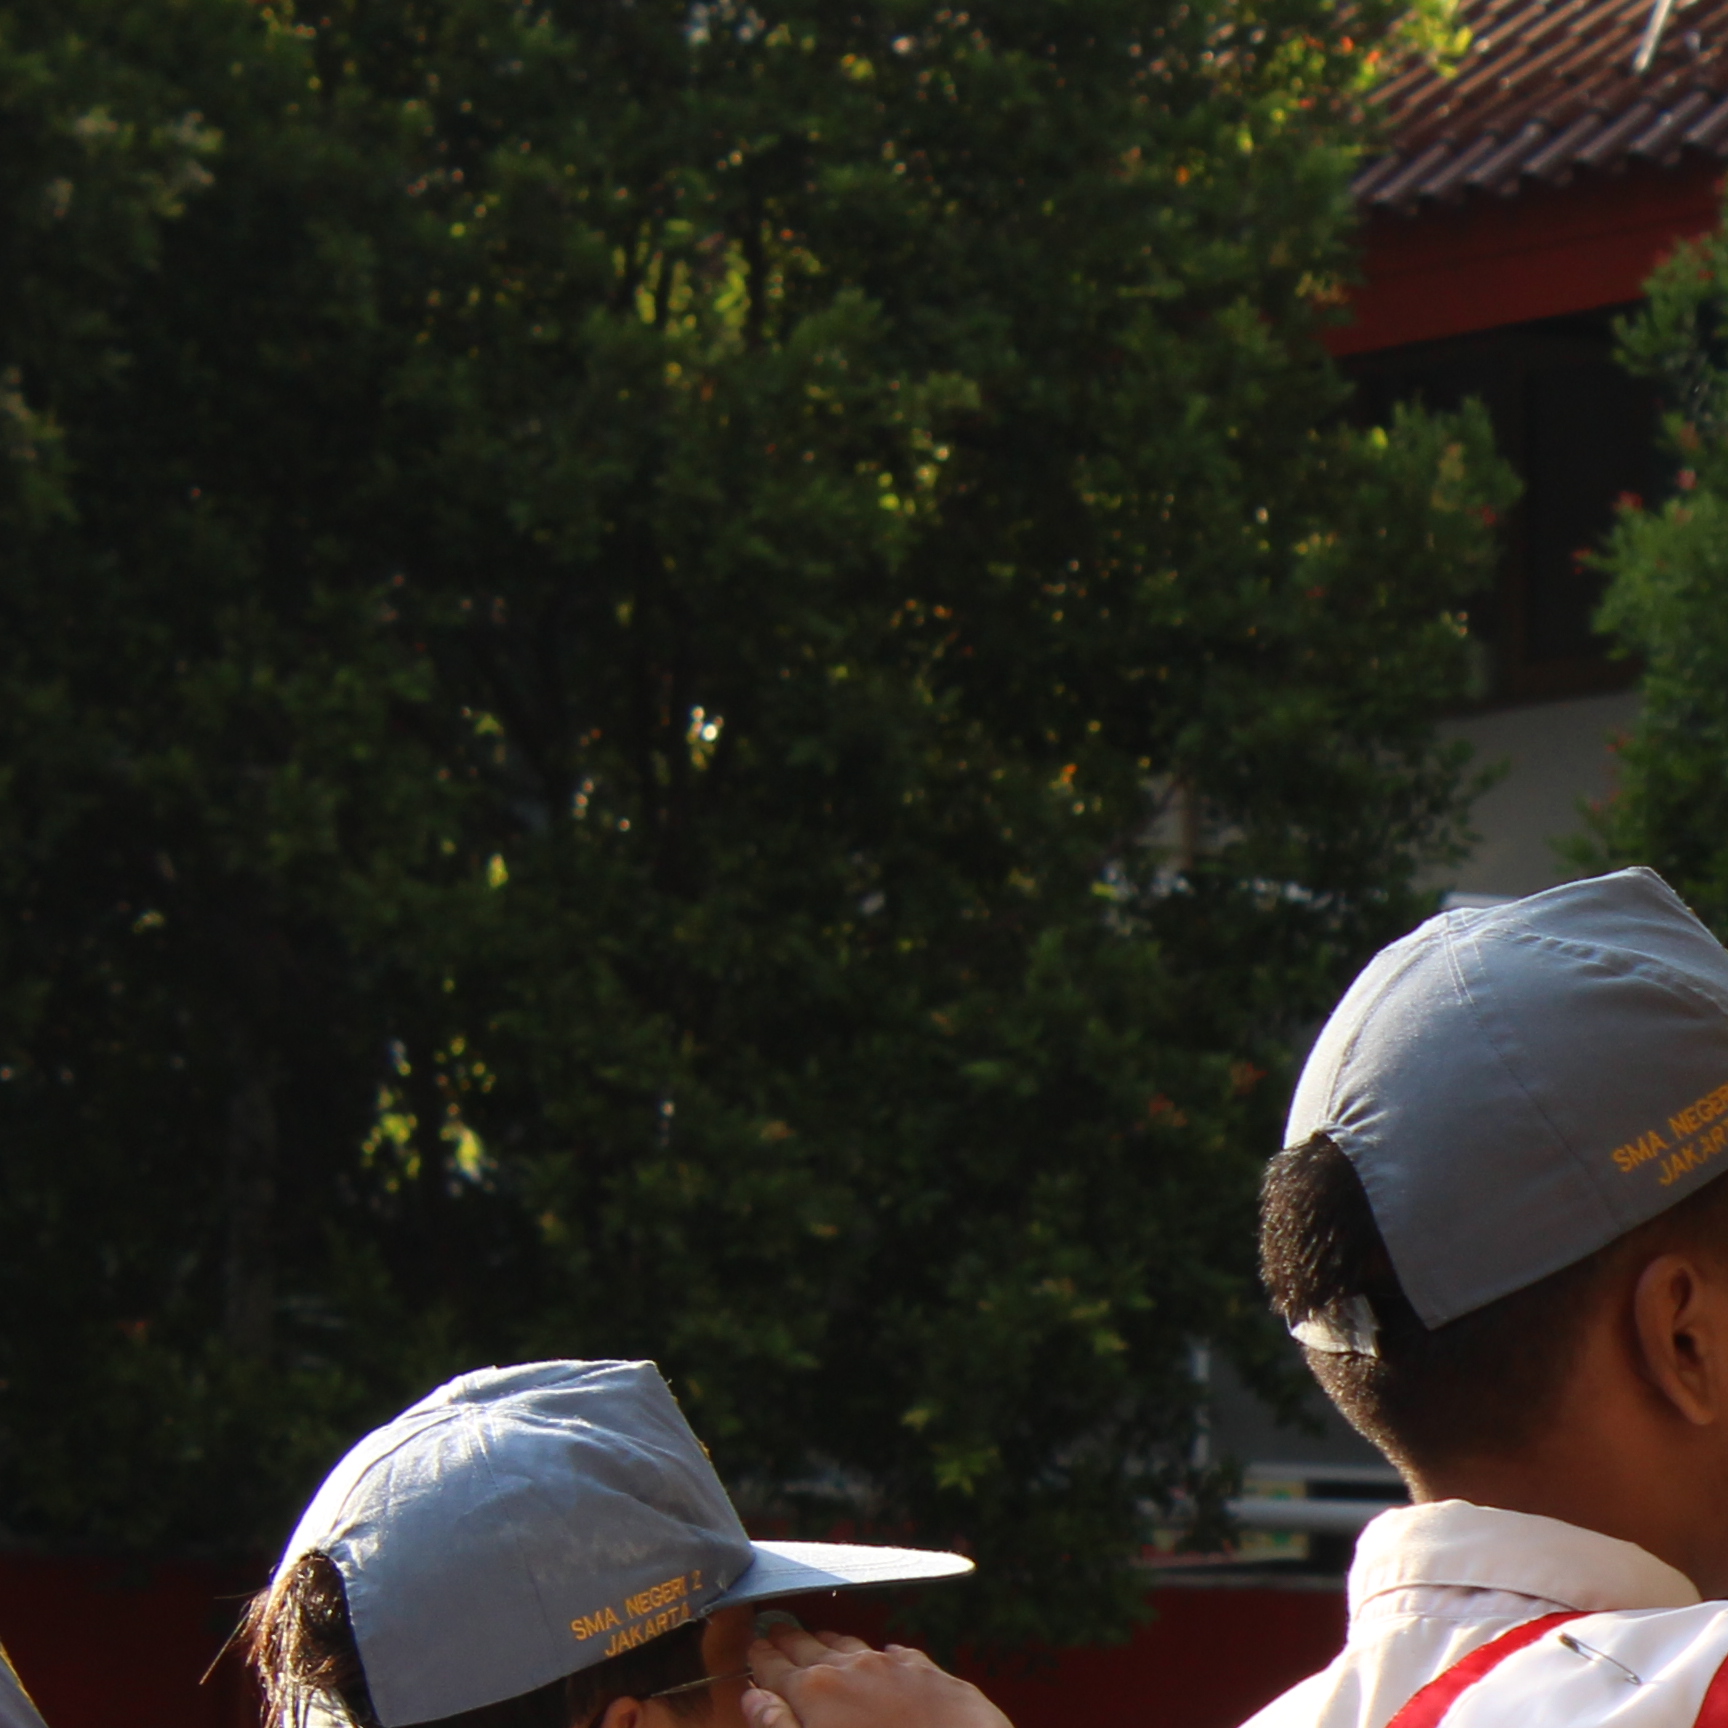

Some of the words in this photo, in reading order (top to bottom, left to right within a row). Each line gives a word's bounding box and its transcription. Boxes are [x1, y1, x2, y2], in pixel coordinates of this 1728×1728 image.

[1612, 1130, 1668, 1172] SMA
[570, 1606, 623, 1642] SMA
[624, 1576, 689, 1619] NEGERI
[605, 1602, 691, 1656] JAKARTA
